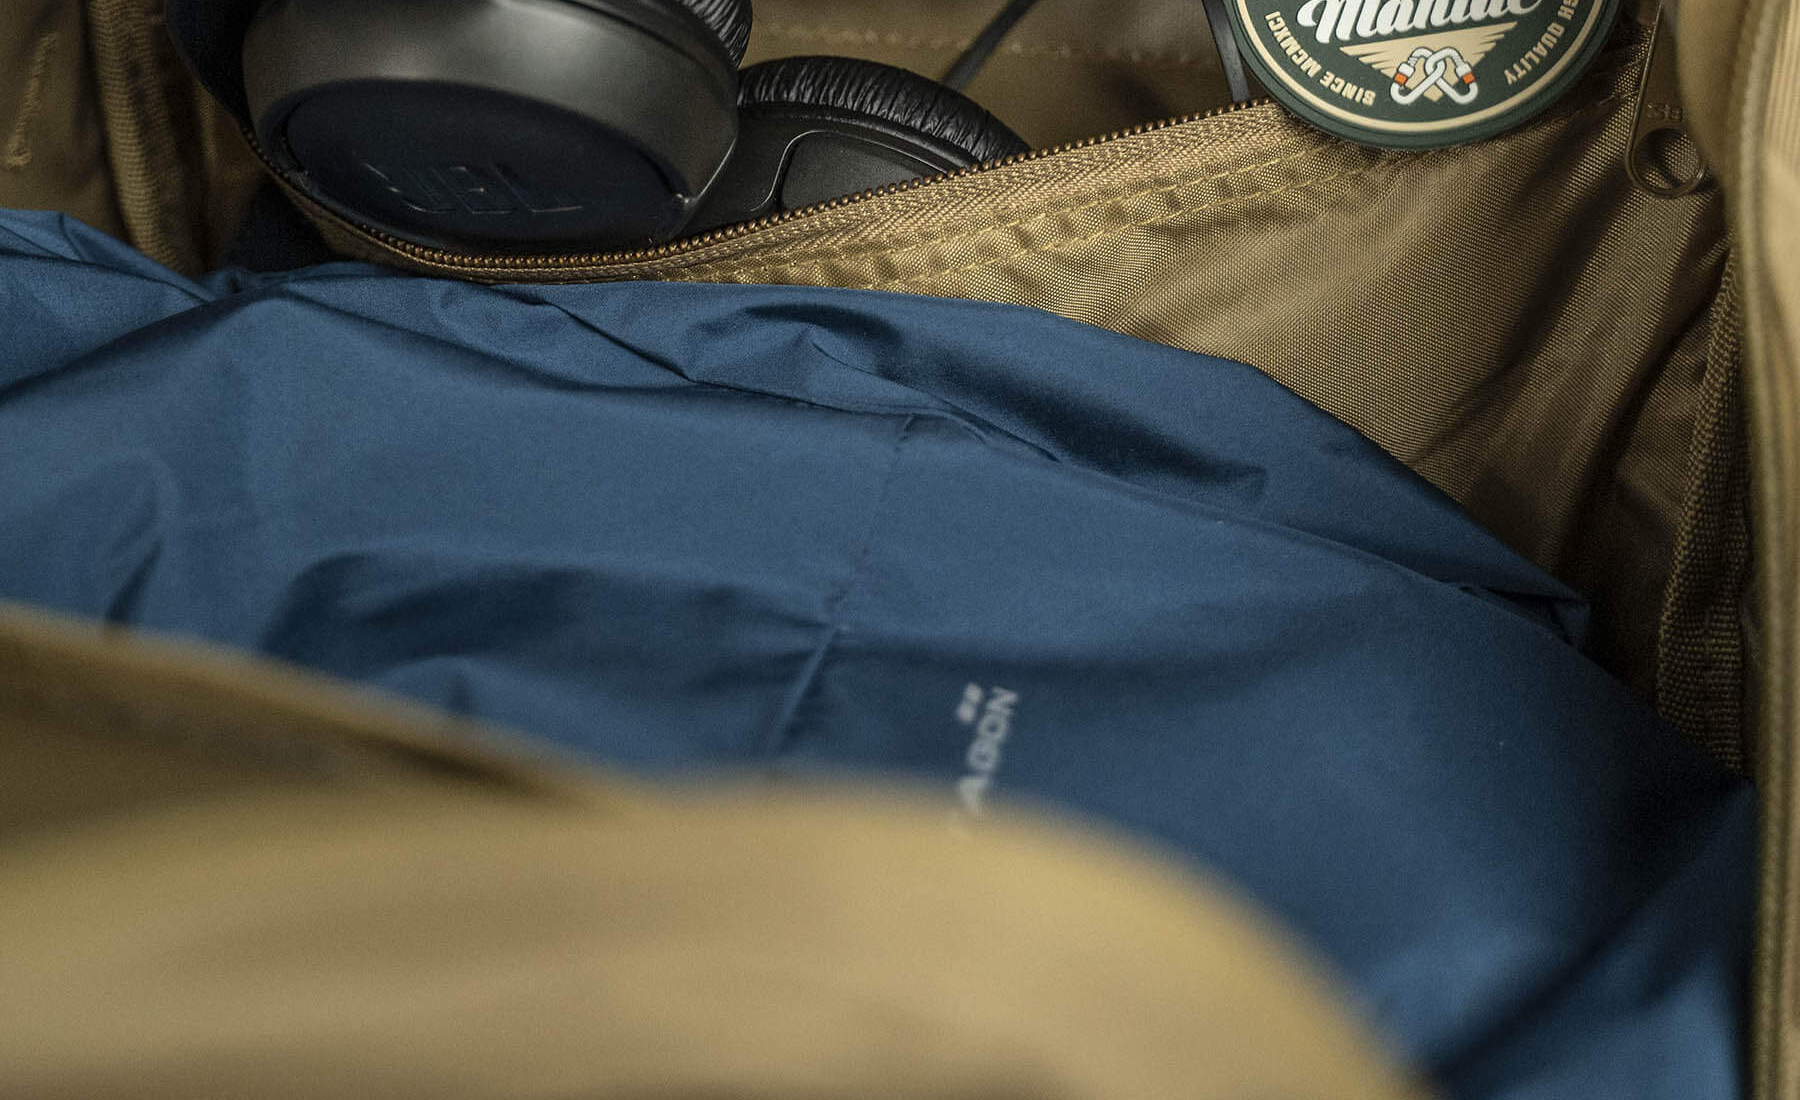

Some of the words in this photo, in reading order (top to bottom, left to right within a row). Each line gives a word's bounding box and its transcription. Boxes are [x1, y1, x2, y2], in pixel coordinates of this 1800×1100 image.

[1264, 10, 1323, 79] MCMXCI
[1503, 21, 1566, 86] QUALITY
[1319, 70, 1377, 107] SINCE
